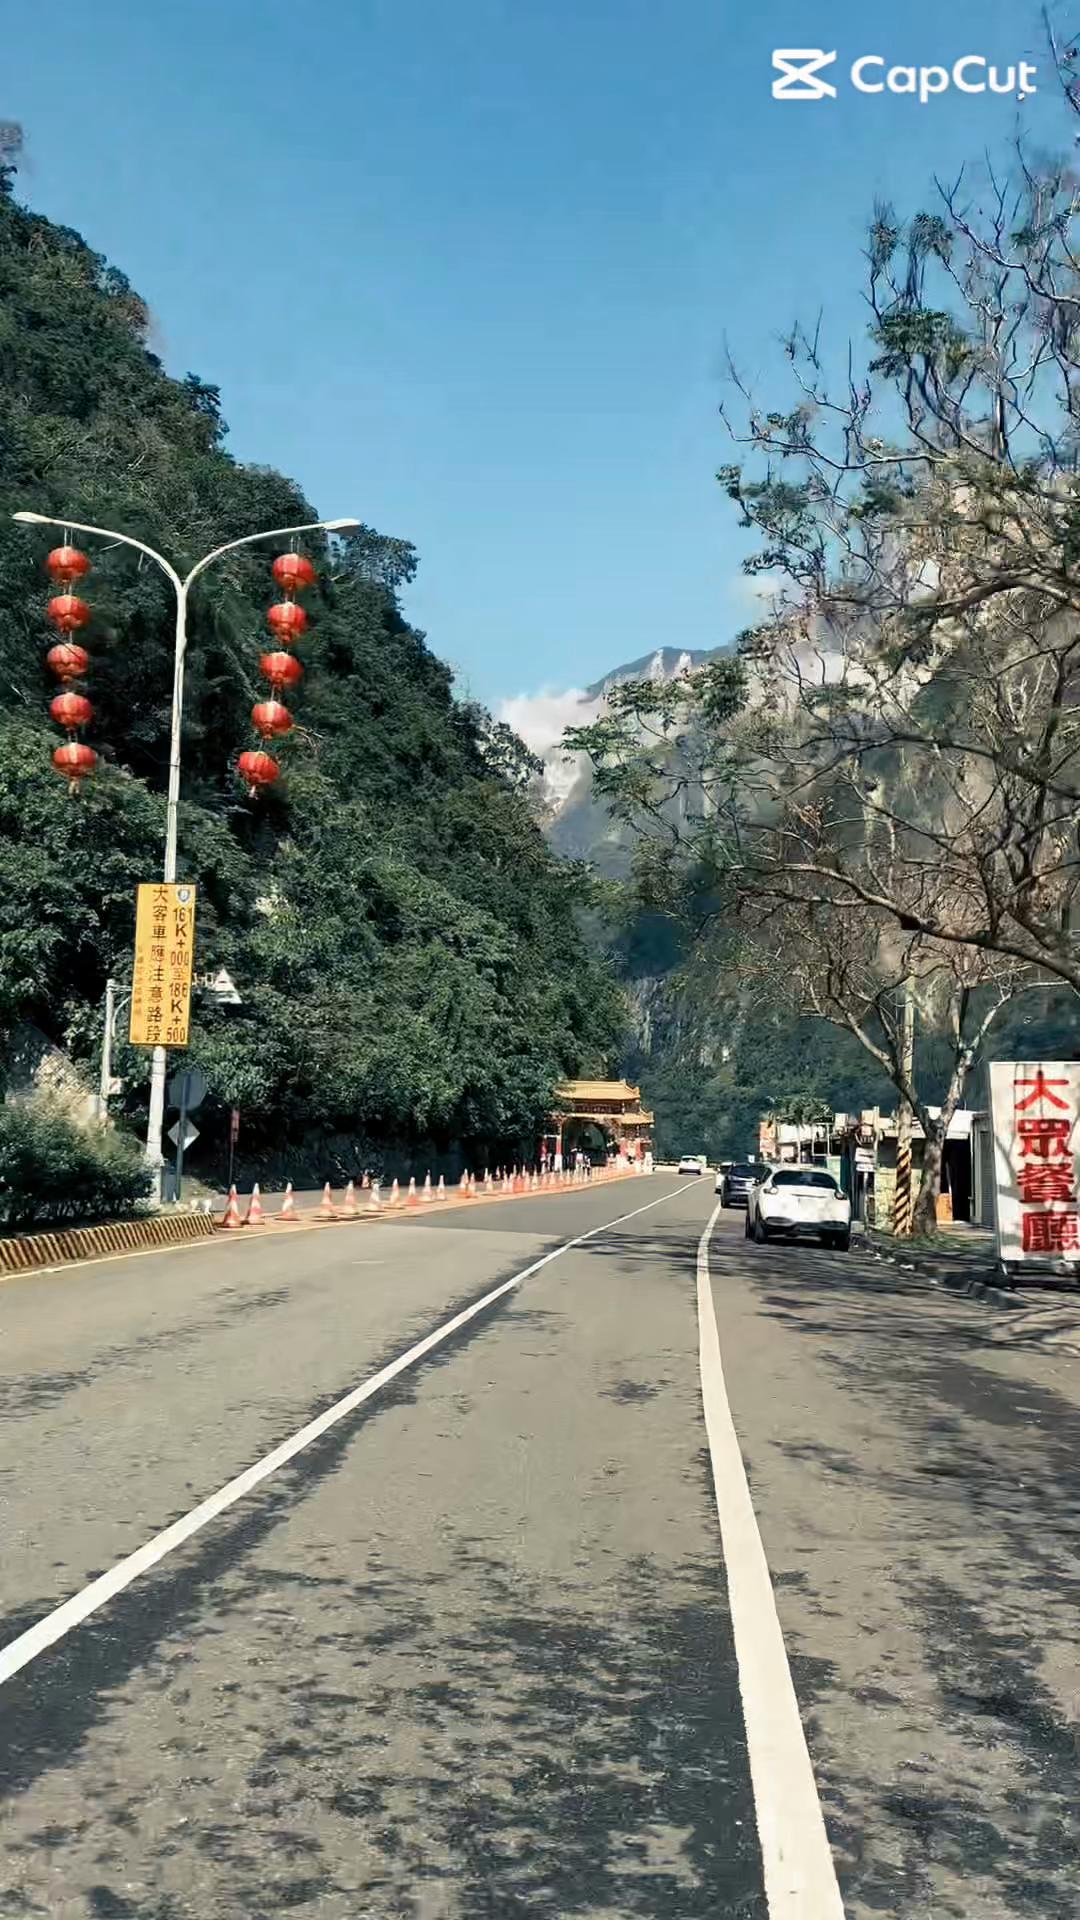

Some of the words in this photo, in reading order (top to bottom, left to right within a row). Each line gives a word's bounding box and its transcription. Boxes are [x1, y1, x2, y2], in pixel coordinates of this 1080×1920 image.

[146, 886, 169, 1042] 大客車應注意路段
